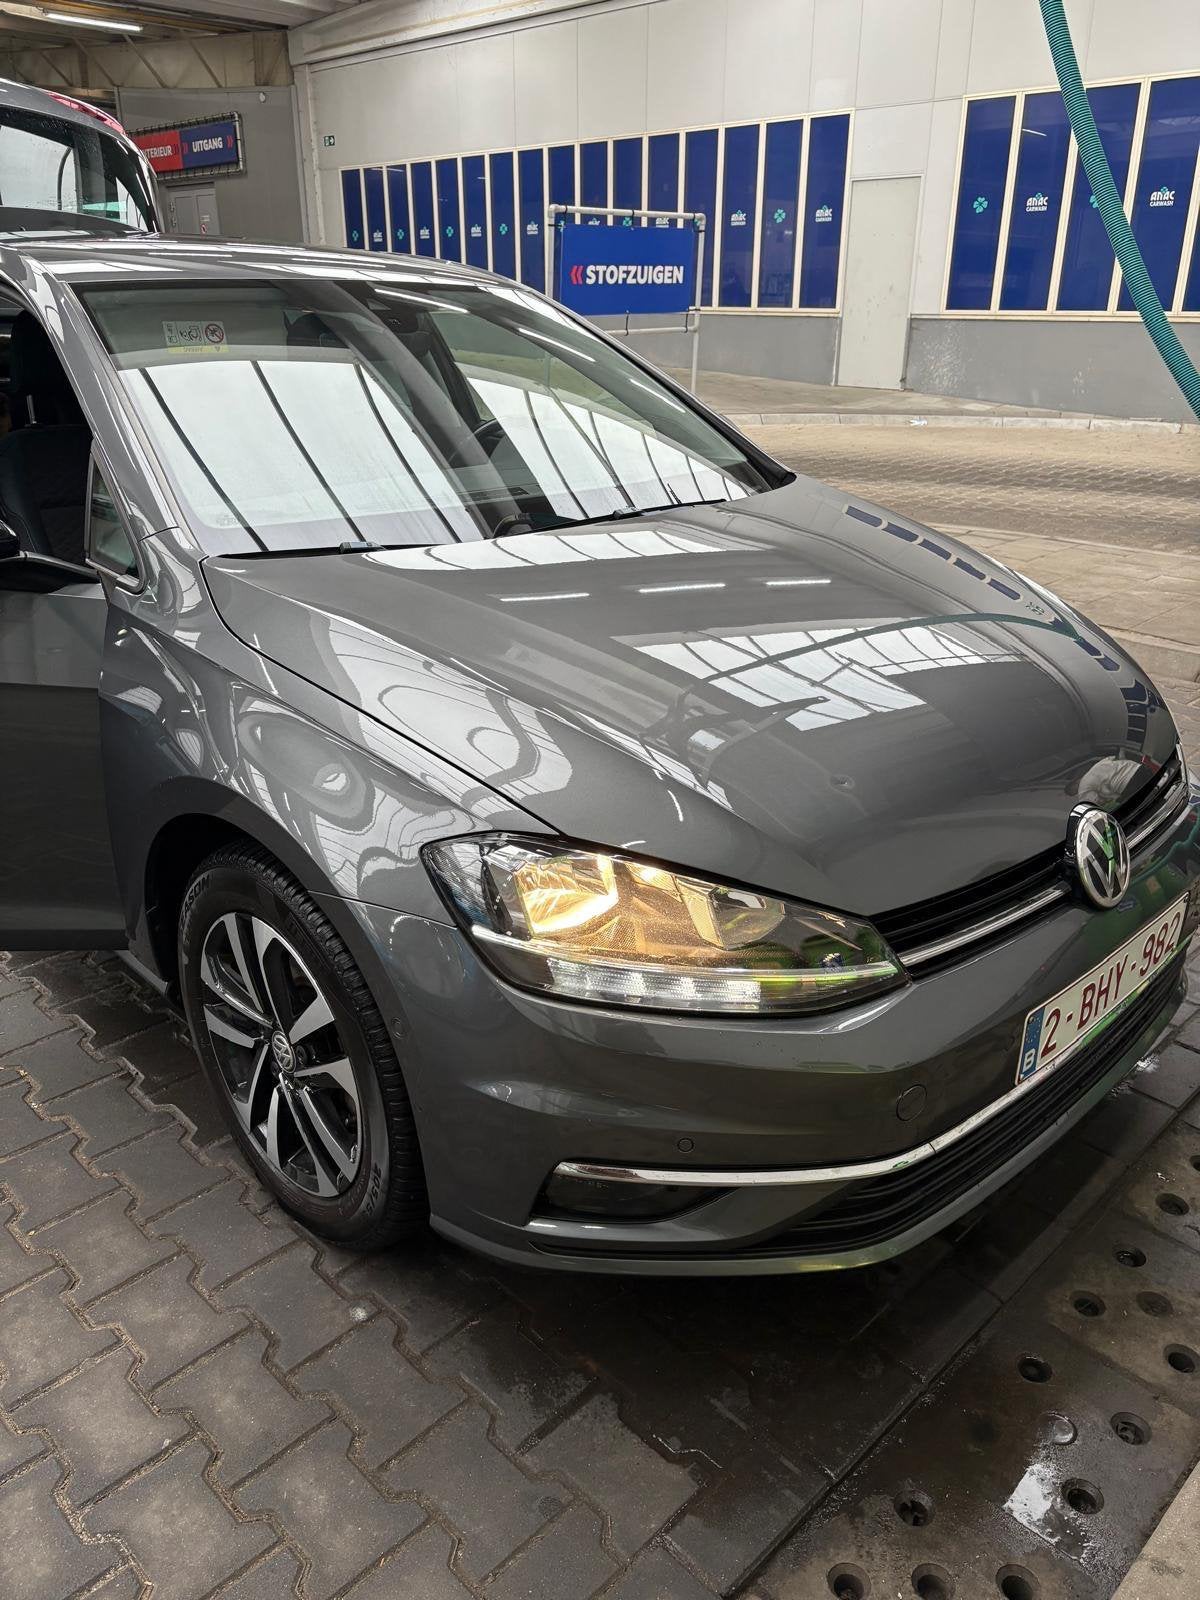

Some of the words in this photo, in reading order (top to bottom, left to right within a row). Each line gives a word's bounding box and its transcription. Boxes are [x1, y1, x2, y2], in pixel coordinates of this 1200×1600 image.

[192, 136, 223, 153] UITGANG
[1026, 196, 1049, 206] ANAC
[1150, 190, 1176, 201] ANAC
[585, 264, 684, 285] STOFZUIGEN
[1040, 911, 1181, 1059] 2-BHY-982
[1023, 1048, 1036, 1073] B
